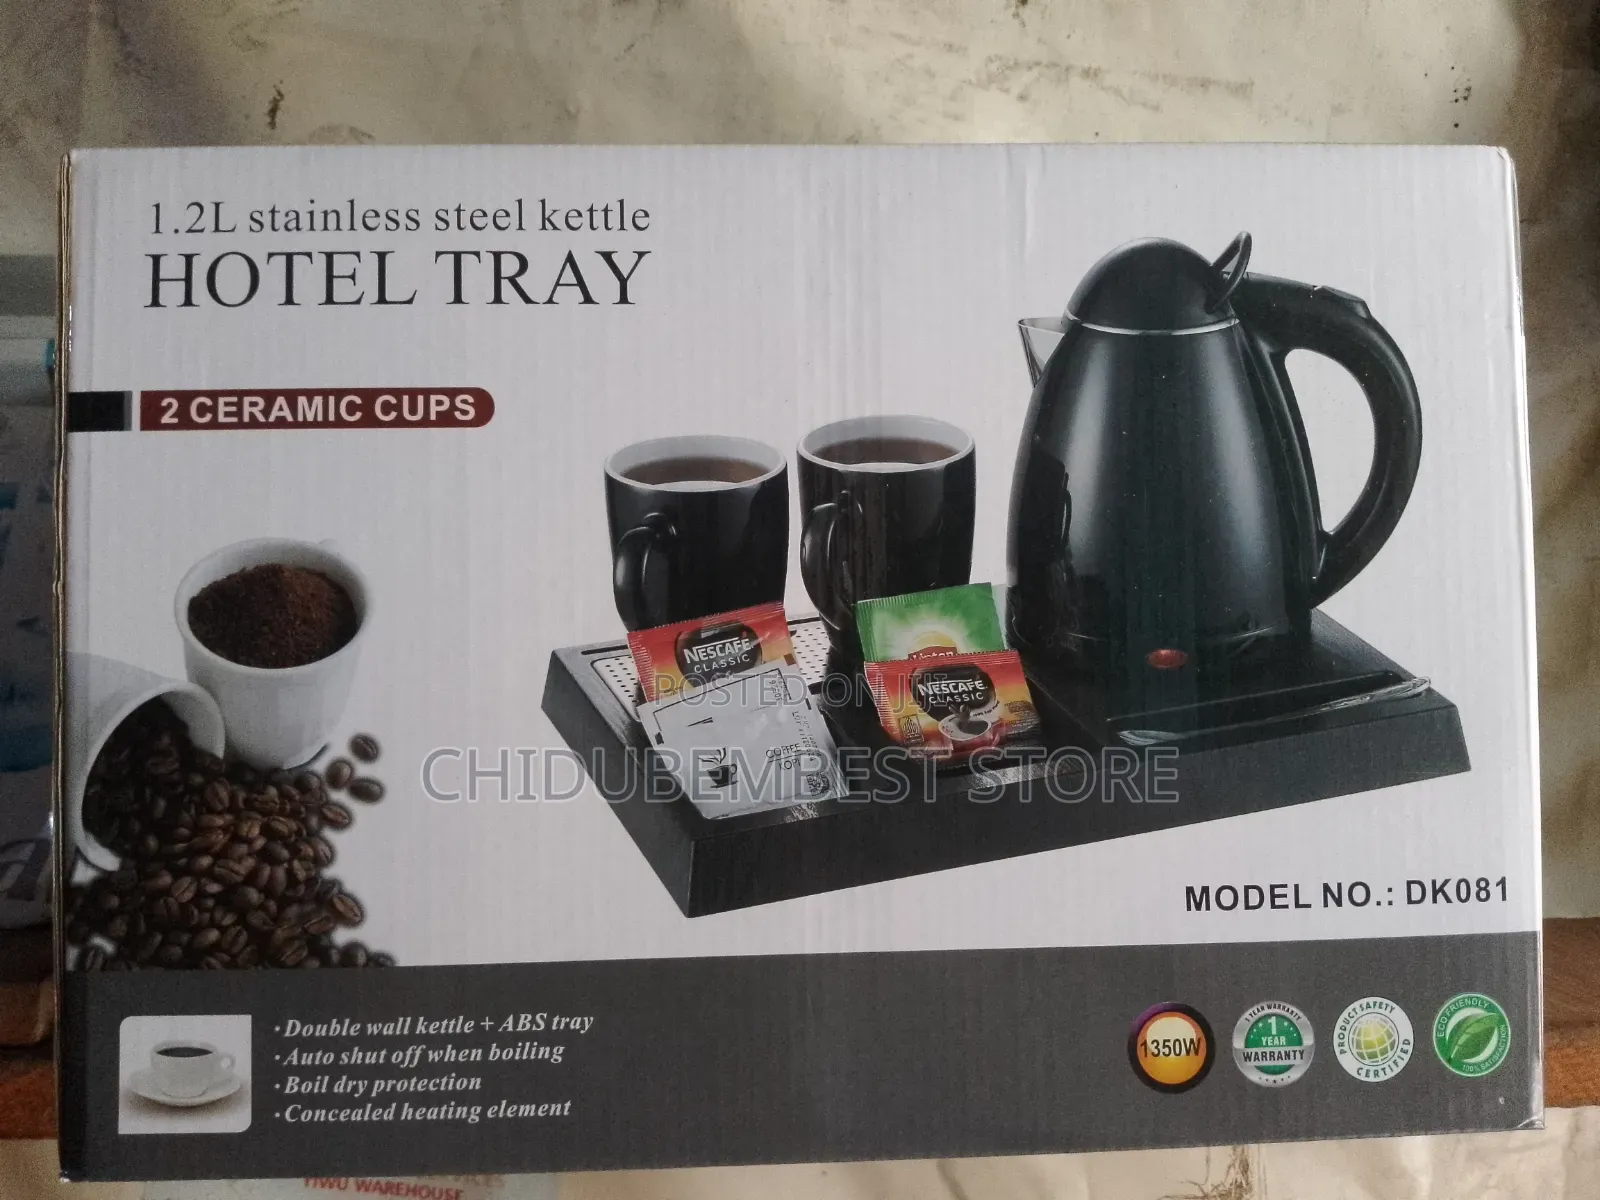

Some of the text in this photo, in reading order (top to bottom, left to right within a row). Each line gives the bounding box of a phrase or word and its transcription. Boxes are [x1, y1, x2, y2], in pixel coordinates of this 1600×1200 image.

[150, 198, 651, 235] 1.2L stainless steel kettle
[144, 249, 652, 308] HOTEL TRAY
[160, 393, 477, 424] 2 CERAMIC CUPS
[693, 653, 751, 674] CLASSIC
[928, 691, 985, 704] CLASSIC
[765, 743, 801, 760] COFFEE
[1185, 876, 1508, 912] MODEL NO.: DK081
[1248, 1005, 1266, 1018] YEAR
[1266, 1002, 1302, 1021] WARRANTY
[1437, 997, 1490, 1037] ECO FRIENDLY
[284, 1012, 594, 1038] Double wall kettle + ABS tray
[1267, 1015, 1277, 1036] 1
[1337, 1000, 1396, 1056] PRODUCT SAFETY
[1140, 1037, 1202, 1059] 1350W
[1261, 1035, 1287, 1046] YEAR
[1480, 1023, 1507, 1071] SATISFACTION
[283, 1041, 565, 1068] Auto shut off when boiling
[1242, 1049, 1305, 1063] WARRANTY
[1356, 1038, 1411, 1079] CERTIFIED
[284, 1072, 483, 1098] Boil dry protection
[284, 1099, 572, 1124] Concealed heating element
[355, 1178, 465, 1200] WAREHOUSE
